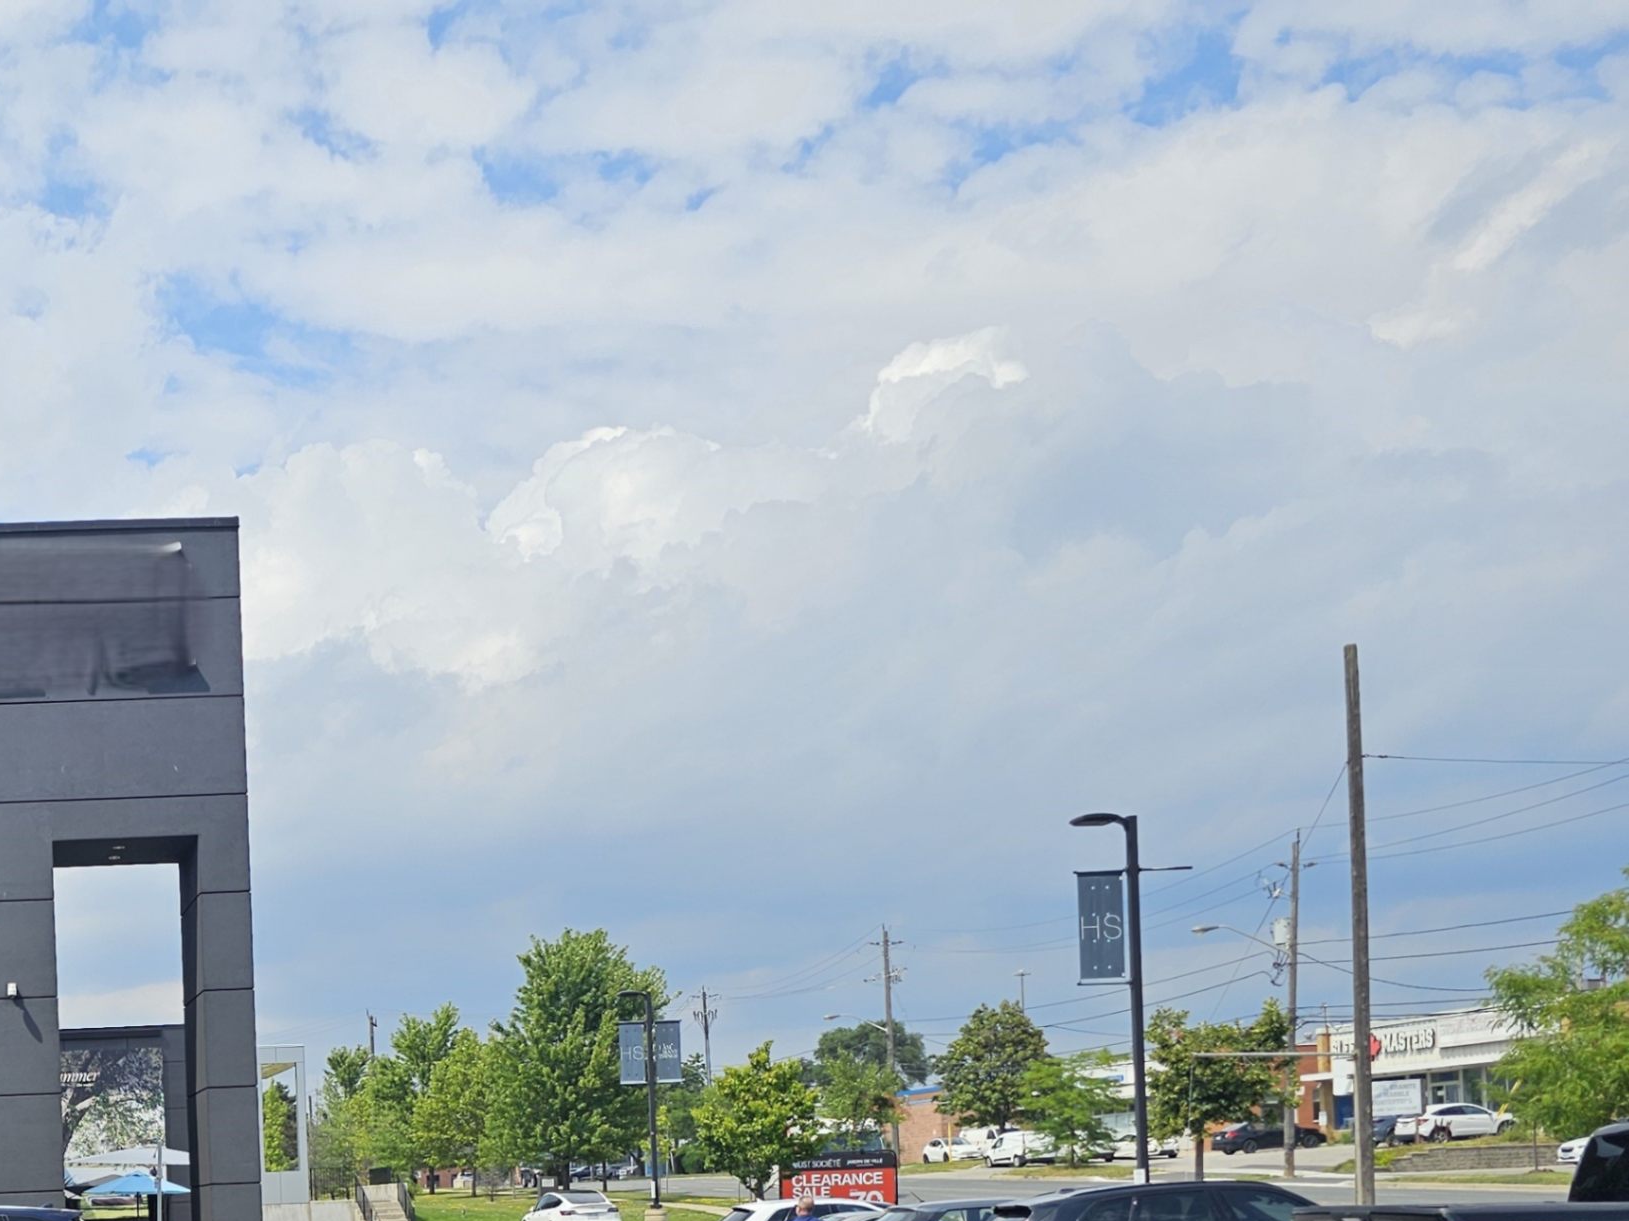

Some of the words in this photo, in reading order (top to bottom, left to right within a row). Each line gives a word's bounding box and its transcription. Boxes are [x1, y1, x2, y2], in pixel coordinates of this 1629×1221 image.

[1080, 914, 1122, 940] HS
[1382, 1028, 1435, 1053] MASTERS
[619, 1045, 645, 1061] HS
[792, 1172, 884, 1187] CLEARANCE
[792, 1186, 831, 1199] SALE
